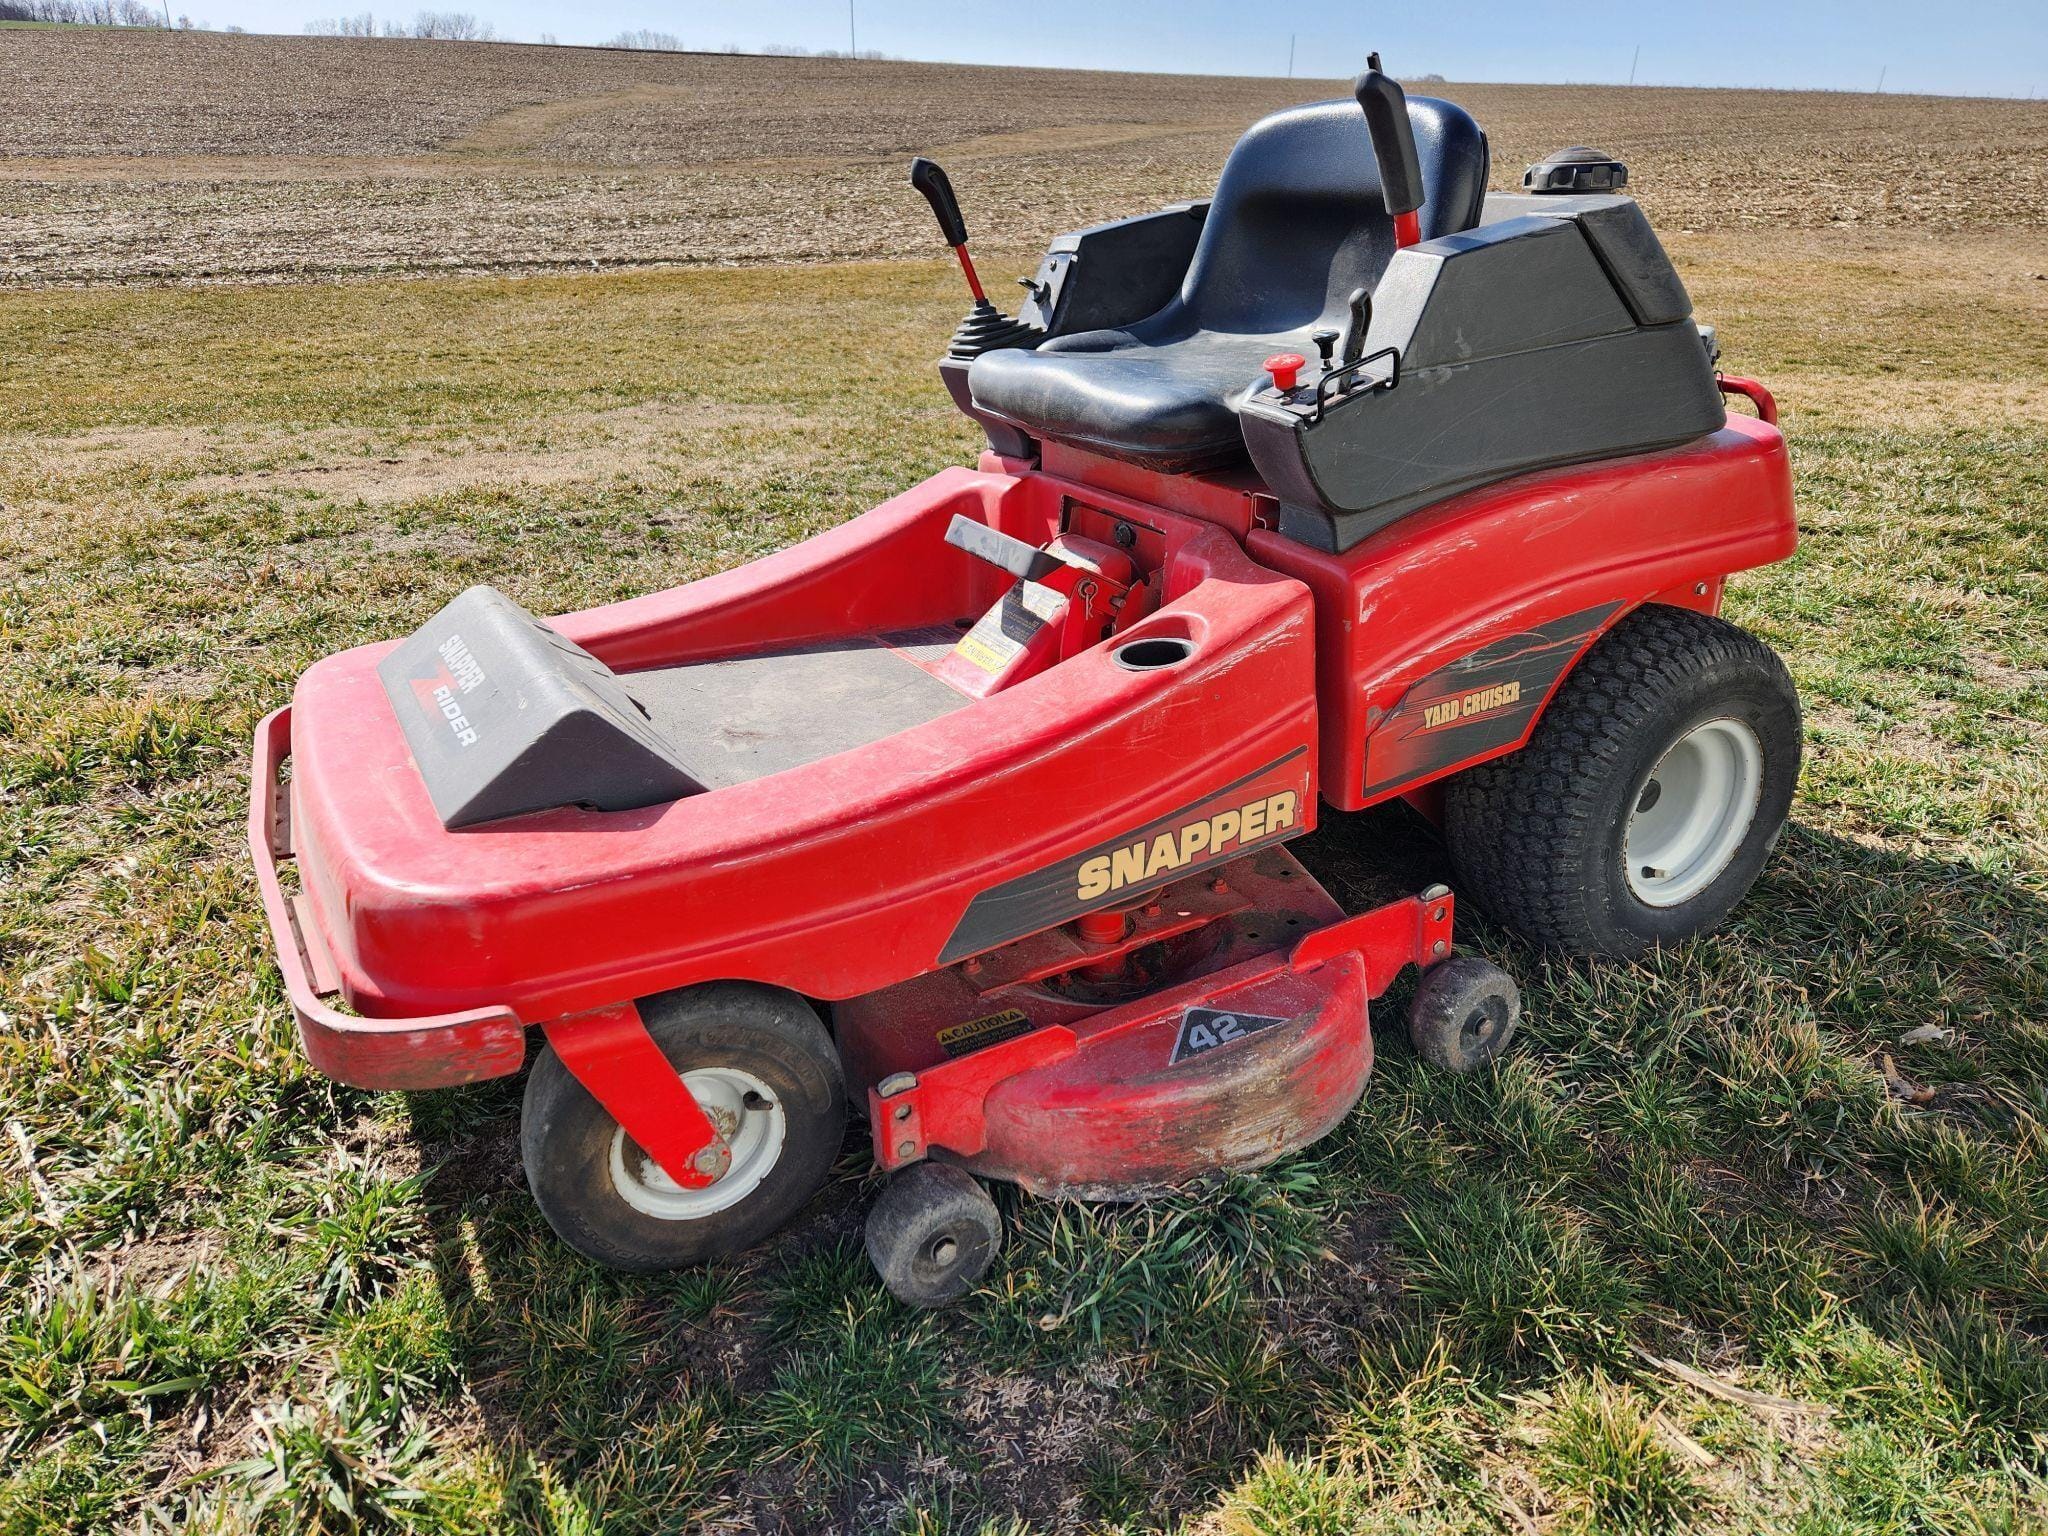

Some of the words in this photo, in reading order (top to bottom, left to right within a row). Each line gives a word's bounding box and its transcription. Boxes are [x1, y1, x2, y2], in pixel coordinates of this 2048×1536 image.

[438, 634, 486, 695] SNAPPER
[433, 684, 478, 747] RIDER
[1423, 699, 1460, 730] YARD
[1462, 681, 1520, 717] CRUISER
[1076, 789, 1297, 901] SNAPPER
[951, 1013, 1008, 1039] CAUTION
[1189, 1014, 1247, 1049] 42
